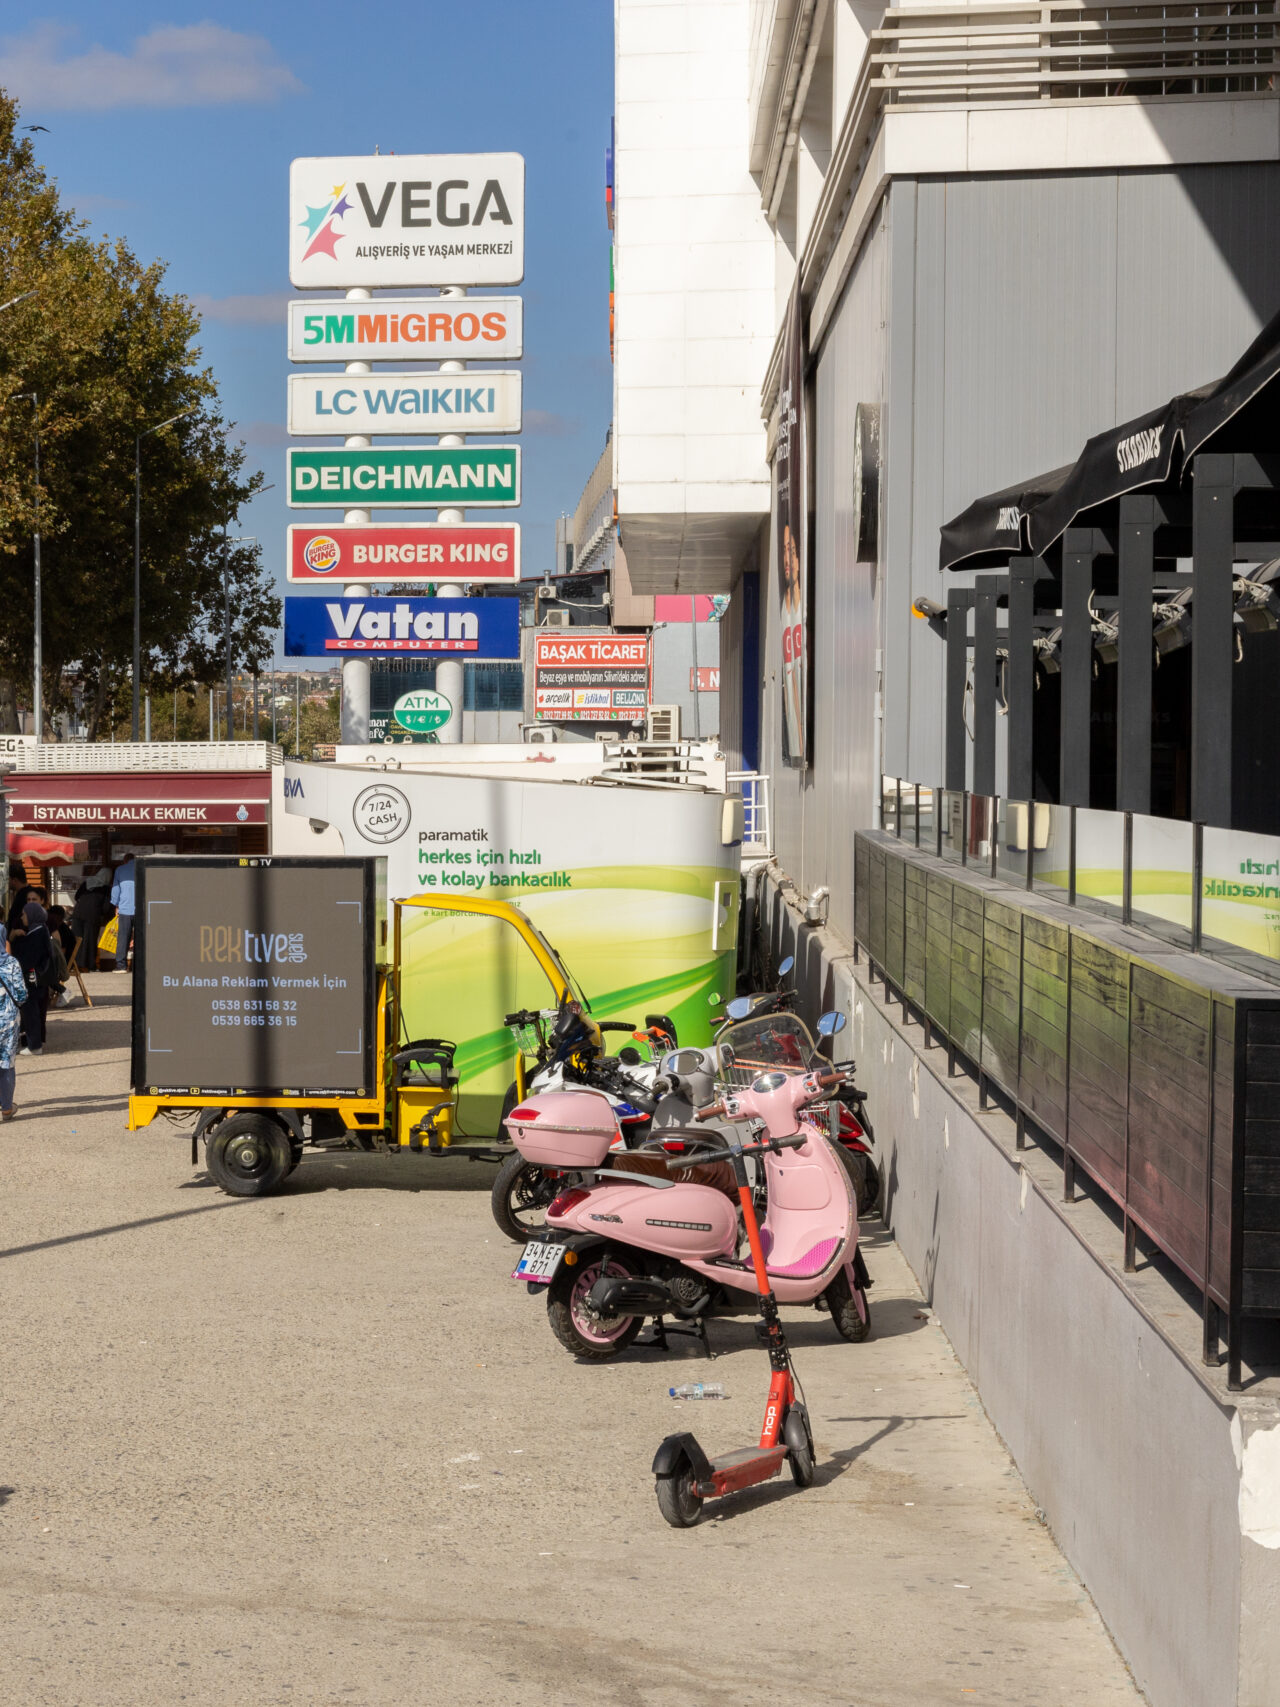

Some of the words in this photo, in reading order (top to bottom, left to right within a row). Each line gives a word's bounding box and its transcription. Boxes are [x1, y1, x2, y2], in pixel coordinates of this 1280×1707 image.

[356, 179, 513, 228] VEGA
[355, 241, 410, 260] ALIŞVERİŞ
[412, 245, 425, 257] VE
[428, 243, 464, 259] YAŞAM
[466, 240, 513, 256] MERKEZİ
[316, 389, 357, 415] LC
[296, 463, 513, 491] DEICHMANN
[309, 543, 335, 556] BURGER
[310, 549, 336, 565] KING
[353, 545, 443, 564] BURGER
[449, 543, 509, 563] KING
[326, 603, 479, 640] Vatan
[337, 640, 466, 650] COMPUTER
[540, 645, 586, 662] BAŞAK
[590, 641, 646, 659] TİCARET
[539, 671, 555, 686] Beyaz
[568, 674, 574, 682] ve
[575, 671, 603, 685] mobilyanın
[404, 697, 439, 708] ATM
[545, 692, 570, 706] arçelik
[616, 692, 644, 705] BELLONA
[284, 778, 304, 798] BVA
[33, 805, 106, 819] İSTANBUL
[110, 807, 151, 819] HALK
[154, 807, 207, 819] EKMEK
[369, 800, 392, 812] 7/24
[369, 812, 397, 826] CASH
[418, 829, 488, 844] paramatik
[418, 849, 472, 864] herkes
[476, 849, 504, 867] için
[509, 849, 541, 865] hızlı
[418, 873, 437, 886] ve
[441, 871, 485, 890] kolay
[490, 871, 571, 887] bankacılık
[163, 976, 179, 987] Bu
[182, 976, 218, 987] Alana
[222, 976, 269, 988] Reklam
[271, 977, 320, 988] Vermek
[323, 974, 347, 990] İçin
[212, 1000, 241, 1011] 0538
[243, 1000, 263, 1011] 631
[265, 1000, 280, 1011] 58
[282, 1000, 297, 1011] 32
[212, 1016, 241, 1026] 0539
[243, 1016, 265, 1026] 665
[267, 1016, 282, 1026] 36
[285, 1016, 297, 1026] 15
[529, 1260, 549, 1275] 871
[762, 1406, 777, 1436] hop
